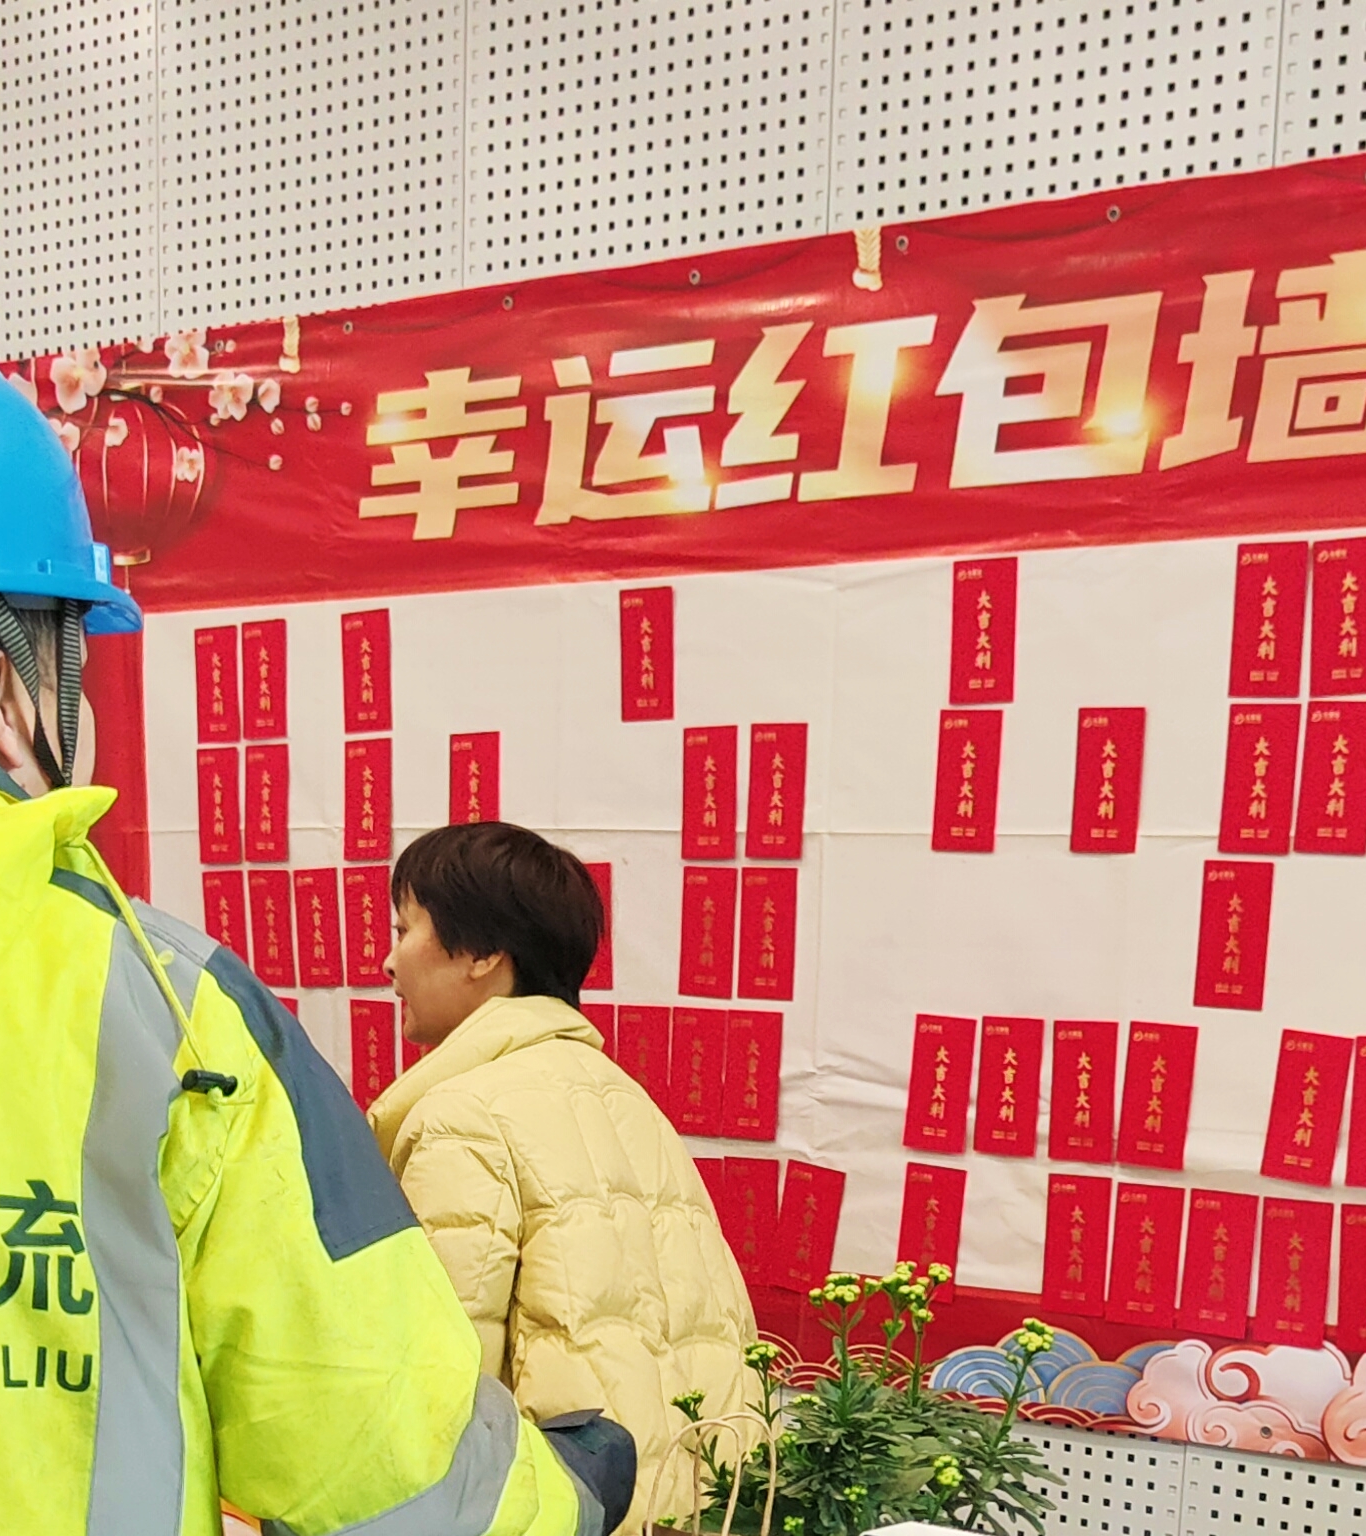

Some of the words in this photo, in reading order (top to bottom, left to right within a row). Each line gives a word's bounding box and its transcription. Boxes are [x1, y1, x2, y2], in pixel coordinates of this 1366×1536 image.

[1258, 576, 1278, 660] 大吉大利
[1249, 737, 1270, 818] 大吉大利
[1326, 734, 1349, 817] 大吉大利
[219, 896, 232, 948] 大吉大
[1223, 894, 1243, 974] 大吉大利
[1145, 1055, 1166, 1132] 大吉大利
[1293, 1066, 1319, 1147] 大吉大利
[796, 1193, 818, 1262] 大吉大利
[1135, 1216, 1155, 1293] 大吉大利
[1209, 1223, 1229, 1300] 大吉大利
[1284, 1232, 1304, 1312] 大吉大利
